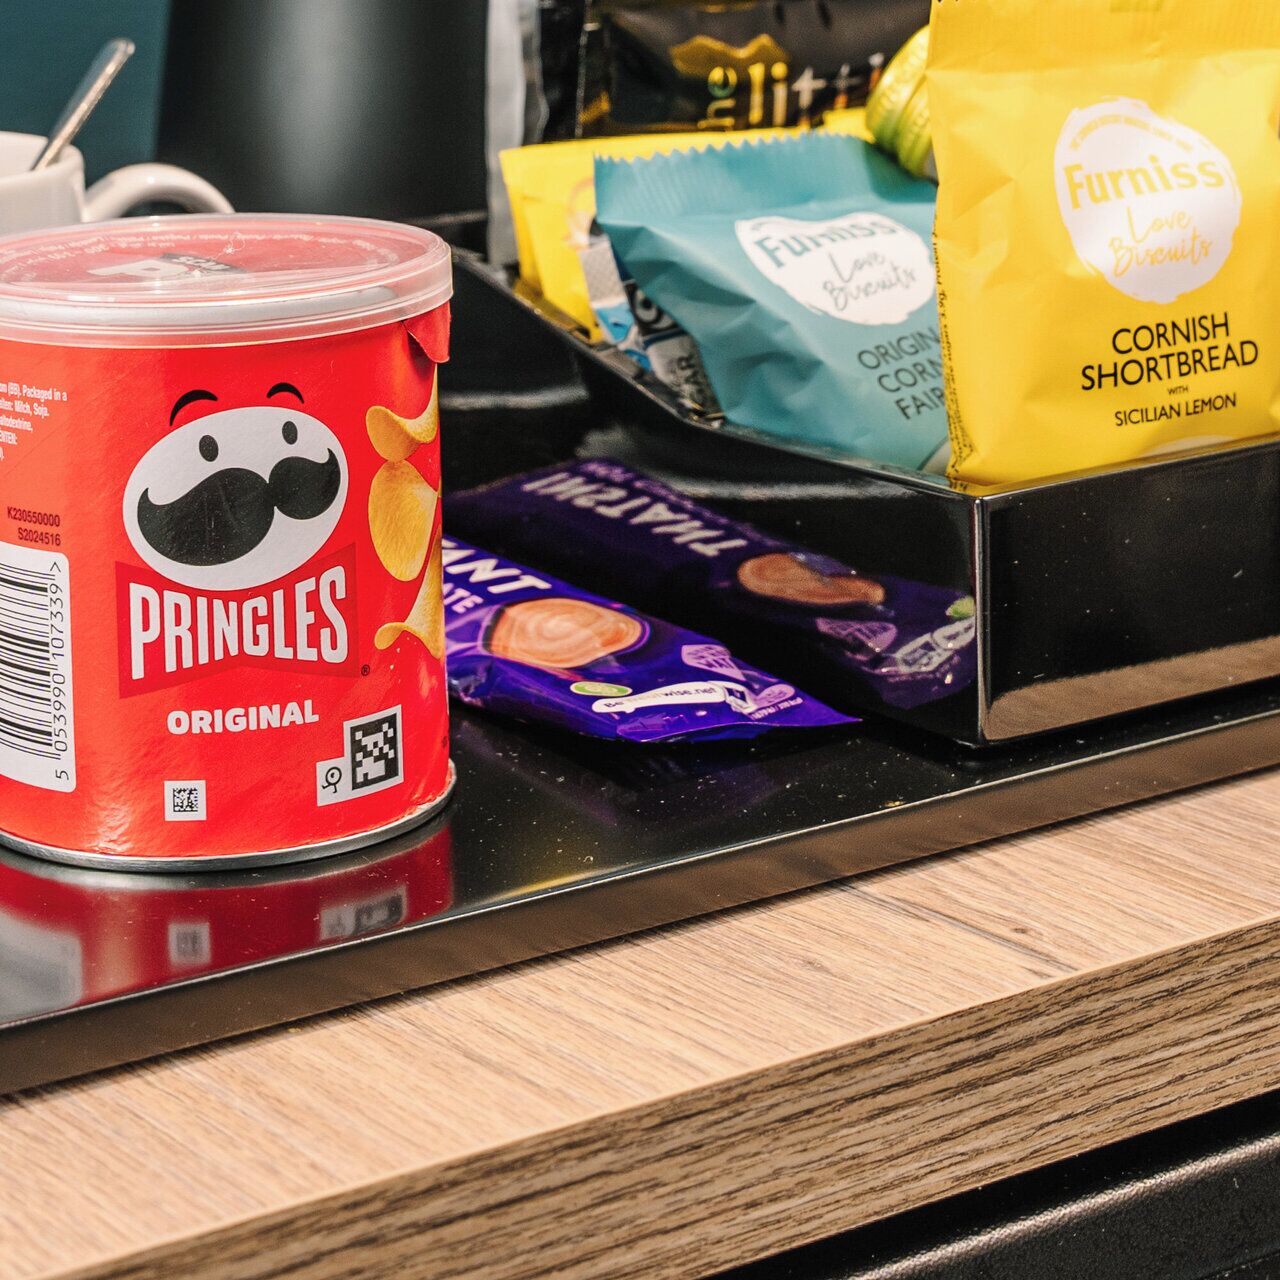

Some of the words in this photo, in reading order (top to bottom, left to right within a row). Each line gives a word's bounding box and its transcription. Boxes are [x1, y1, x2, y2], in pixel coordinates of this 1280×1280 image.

[1063, 154, 1225, 209] Furniss
[1126, 207, 1193, 243] Love
[828, 252, 886, 283] Love
[1109, 226, 1213, 277] Biscuits
[1112, 312, 1230, 354] CORNISH
[1081, 340, 1259, 391] SHORTBREAD
[22, 384, 52, 402] Packaged
[53, 388, 61, 400] in
[61, 391, 67, 401] a
[1167, 385, 1189, 395] WITH
[1114, 402, 1181, 427] SICILIAN
[1185, 392, 1237, 417] LEMON
[7, 506, 60, 528] K230550000
[18, 527, 61, 547] S2024516
[49, 582, 66, 660] 107339
[129, 565, 348, 680] PRINGLES
[53, 673, 68, 752] 053990
[167, 700, 319, 735] ORIGINAL
[55, 769, 69, 781] 5
